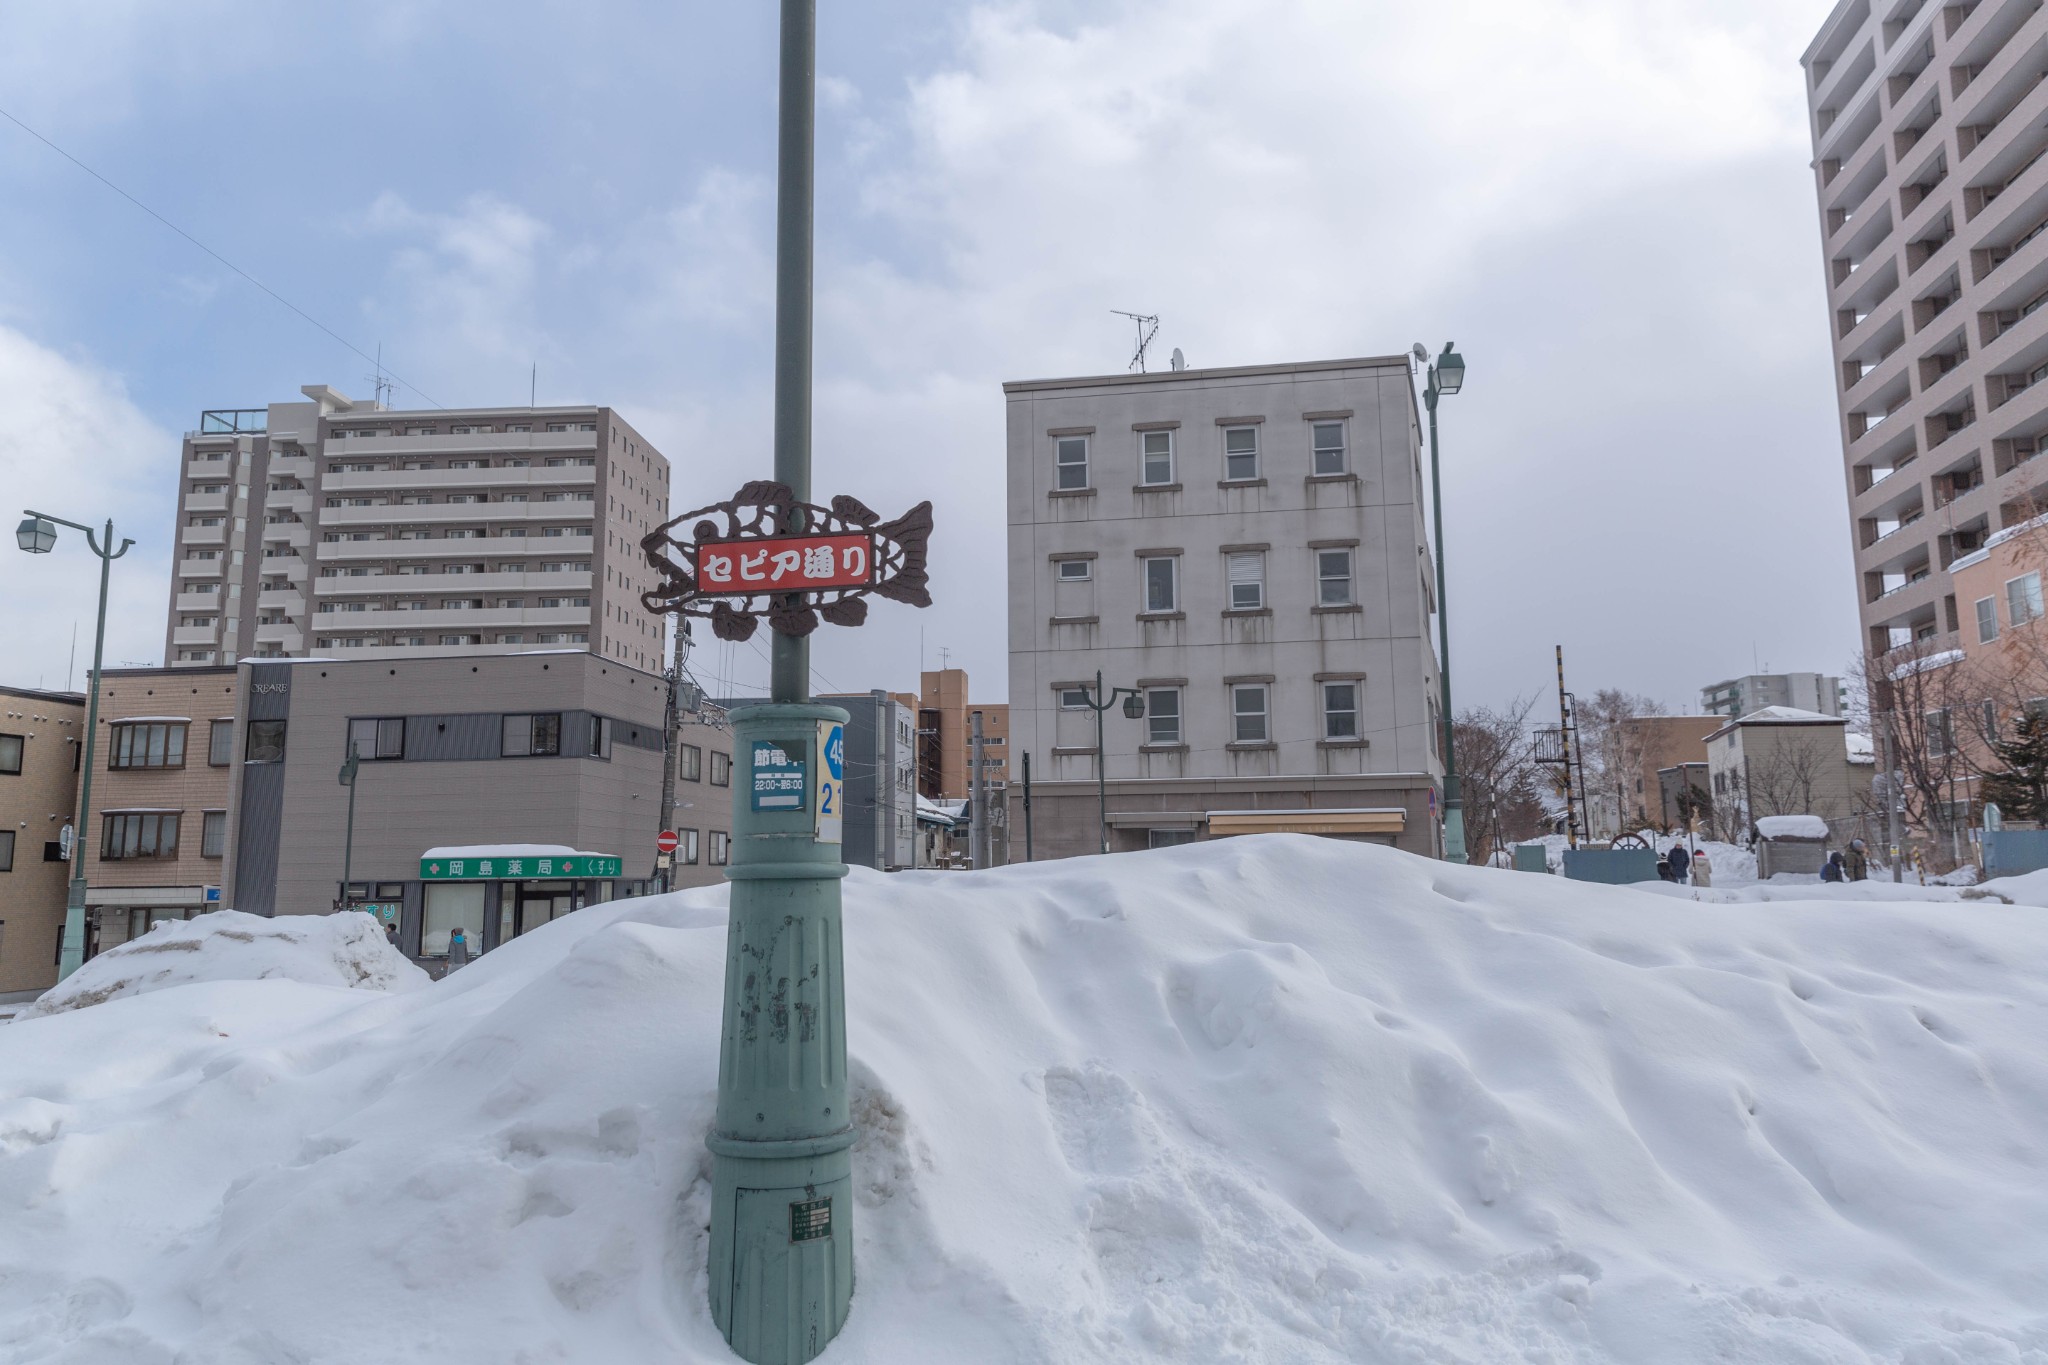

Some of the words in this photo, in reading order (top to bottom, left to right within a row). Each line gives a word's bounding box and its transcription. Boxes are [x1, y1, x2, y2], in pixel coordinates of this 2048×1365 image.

[703, 545, 866, 582] セピア通り
[250, 683, 288, 695] CREARE
[754, 749, 804, 766] 節電
[448, 859, 552, 876] 岡島薬局
[587, 859, 616, 875] くすり
